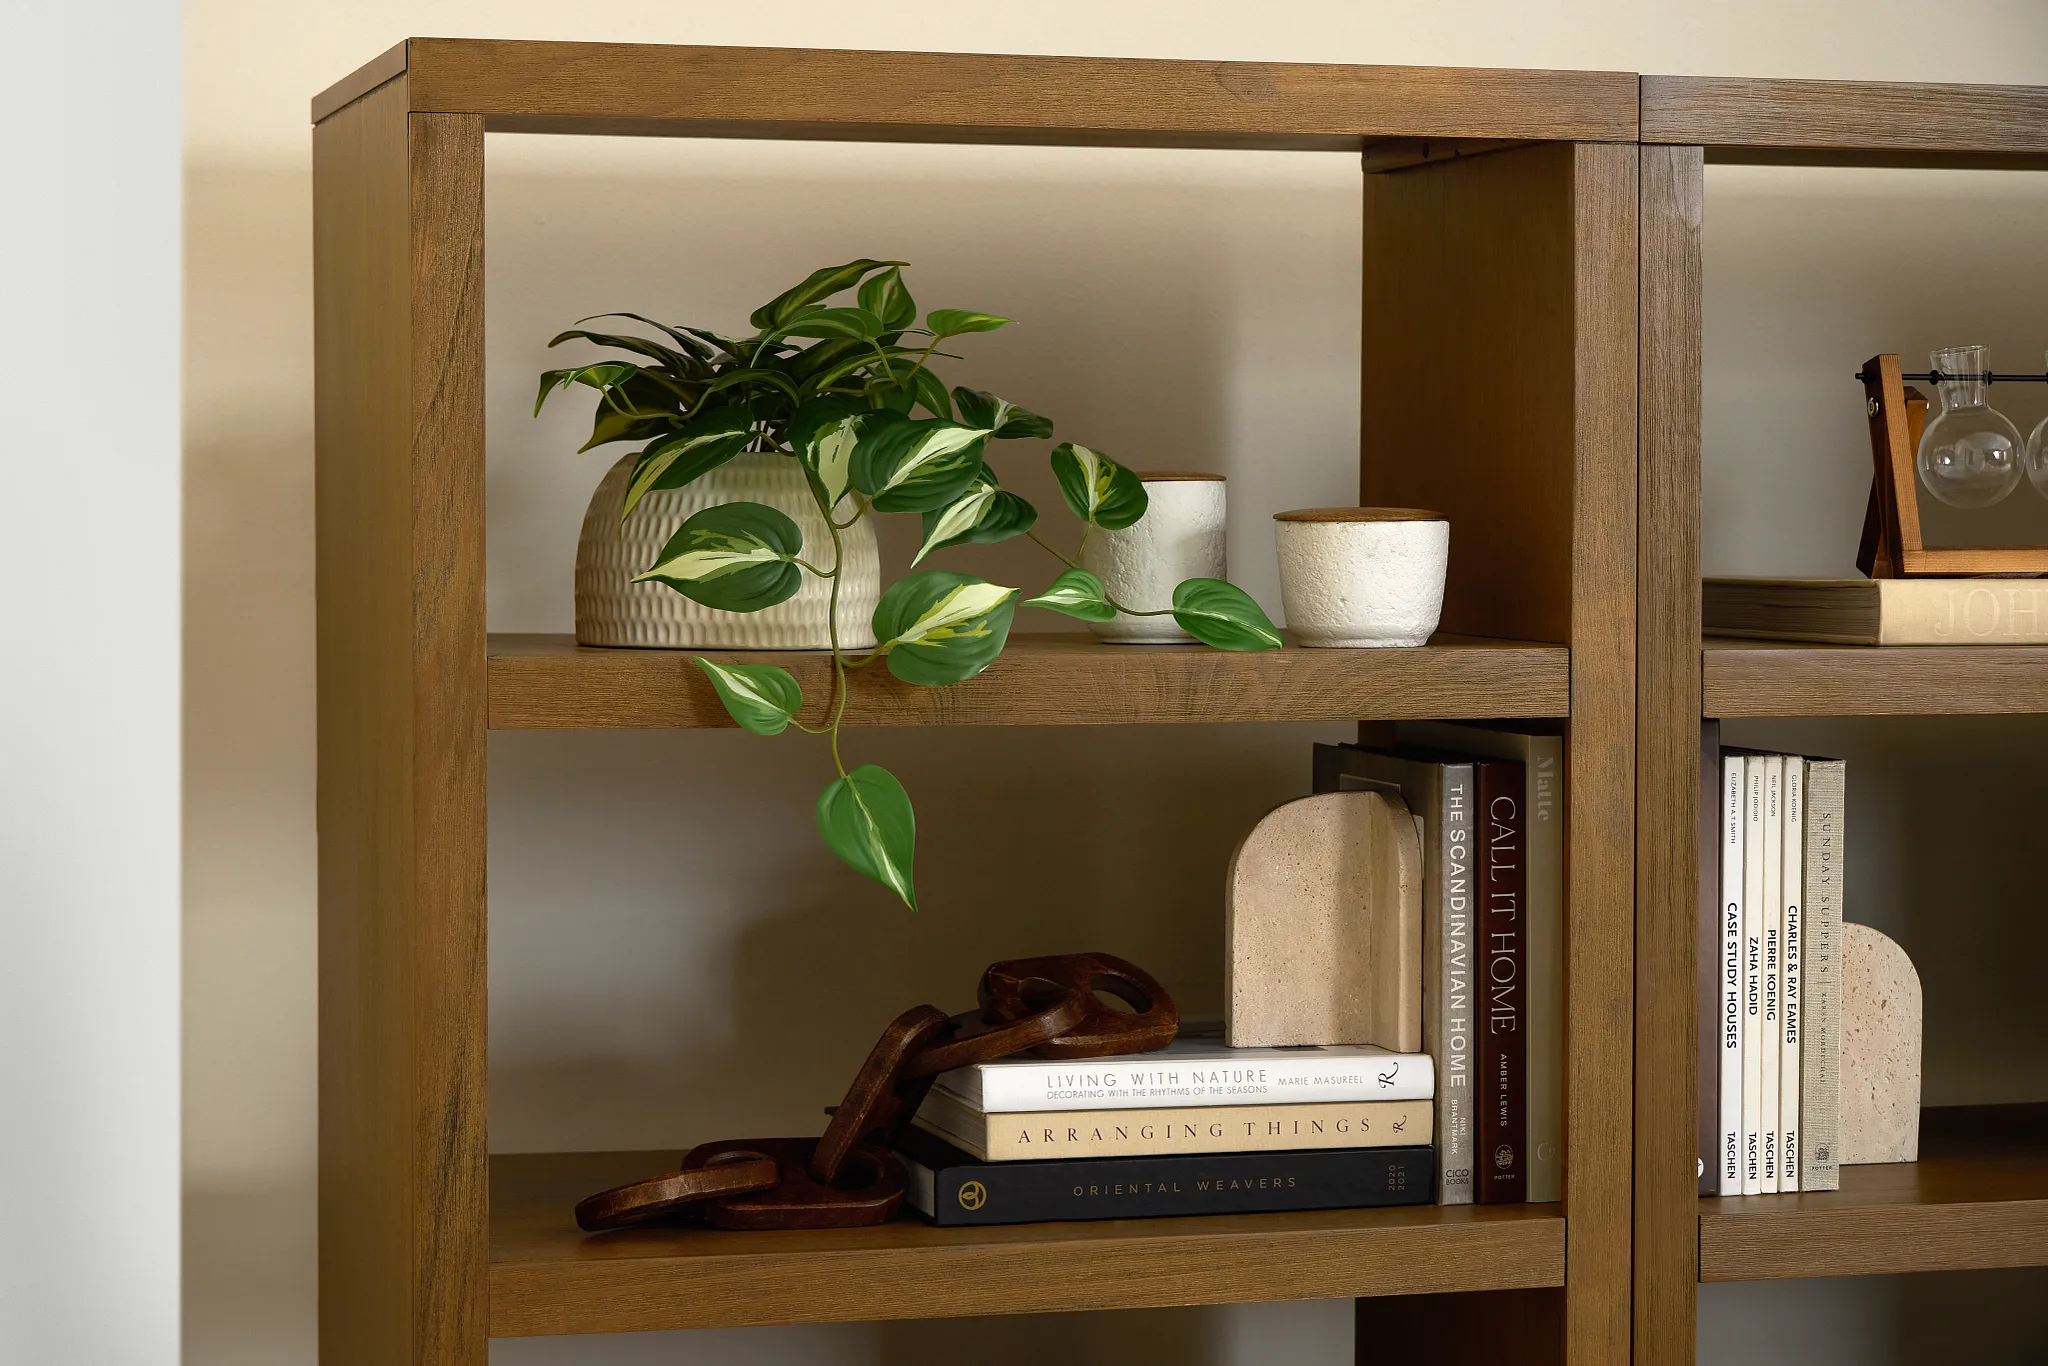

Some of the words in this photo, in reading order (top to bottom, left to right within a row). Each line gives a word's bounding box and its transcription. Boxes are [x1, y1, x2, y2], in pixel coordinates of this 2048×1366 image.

[1933, 588, 2048, 636] JOH
[1450, 784, 1462, 822] THE
[1537, 756, 1554, 821] Matte
[1490, 796, 1516, 882] CALL
[1821, 813, 1831, 885] SUNDAY
[1450, 830, 1466, 1009] SCANDINAVIAN
[1492, 892, 1516, 921] IT
[1727, 903, 1737, 938] CASE
[1750, 936, 1758, 971] ZAHA
[1768, 929, 1776, 970] PIERRE
[1788, 906, 1798, 959] CHARLES
[1820, 896, 1830, 973] SUPPERS
[1490, 932, 1516, 1034] HOME
[1727, 942, 1737, 986] STUDY
[1788, 964, 1797, 972] &
[1749, 975, 1758, 1015] HADID
[1767, 974, 1776, 1020] KOENIG
[1788, 977, 1797, 999] RAY
[1727, 992, 1737, 1048] HOUSES
[1787, 1004, 1796, 1043] EAMES
[1450, 1018, 1466, 1088] HOME
[1047, 1074, 1116, 1088] LIVING
[1131, 1072, 1178, 1085] WITH
[1192, 1070, 1266, 1084] NATURE
[1047, 1090, 1104, 1099] DECORATING
[1132, 1088, 1146, 1097] THE
[1150, 1088, 1190, 1096] RHYTHMS
[1192, 1087, 1206, 1095] OF
[1209, 1086, 1223, 1095] THE
[1227, 1085, 1268, 1094] SEASONS
[1278, 1077, 1309, 1086] MARIE
[1314, 1076, 1363, 1085] MASUREEL
[1018, 1123, 1222, 1143] ARRANGING
[1244, 1118, 1369, 1136] THINGS
[1446, 1169, 1469, 1178] CICO
[1727, 1132, 1735, 1179] TASCHEN
[1766, 1131, 1774, 1178] TASCHEN
[1786, 1130, 1794, 1178] TASCHEN
[1073, 1182, 1180, 1196] ORIENTAL
[1196, 1177, 1296, 1191] WEAVERS
